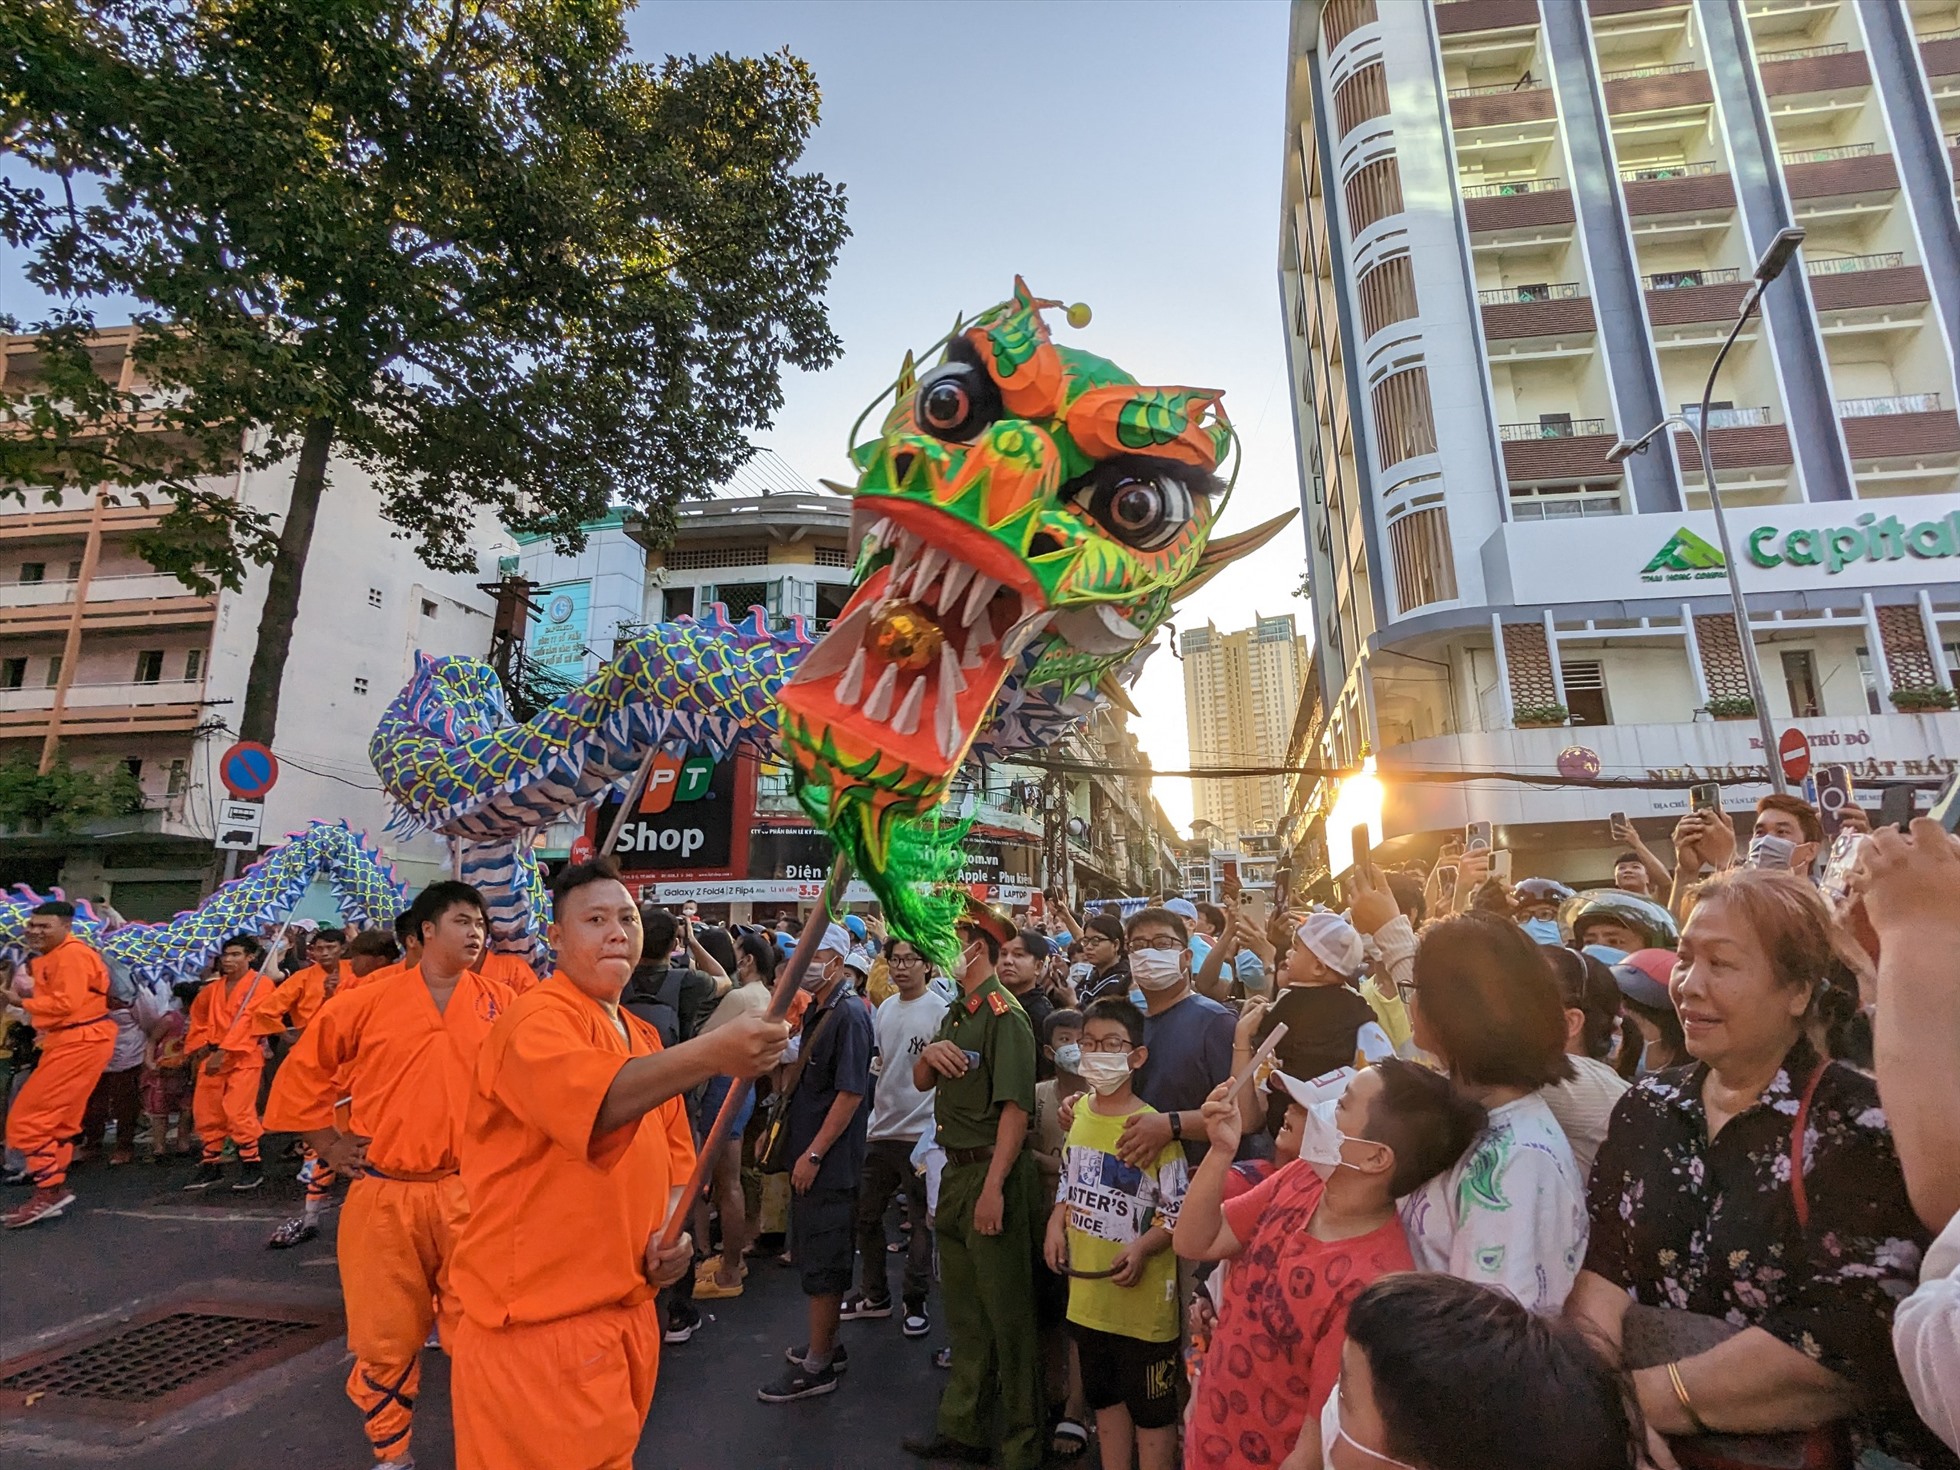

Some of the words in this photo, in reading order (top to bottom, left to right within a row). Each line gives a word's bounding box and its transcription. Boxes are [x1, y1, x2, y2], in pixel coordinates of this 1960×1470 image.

[1845, 729, 1870, 745] ĐÔ
[650, 767, 707, 792] PT
[616, 822, 705, 858] Shop
[786, 865, 821, 882] Điện
[957, 869, 988, 884] Apple
[999, 871, 1015, 887] Phụ
[664, 888, 694, 897] Galaxy
[703, 887, 724, 895] Fold4
[735, 886, 754, 896] Flip4
[1004, 890, 1028, 898] LAPTOP
